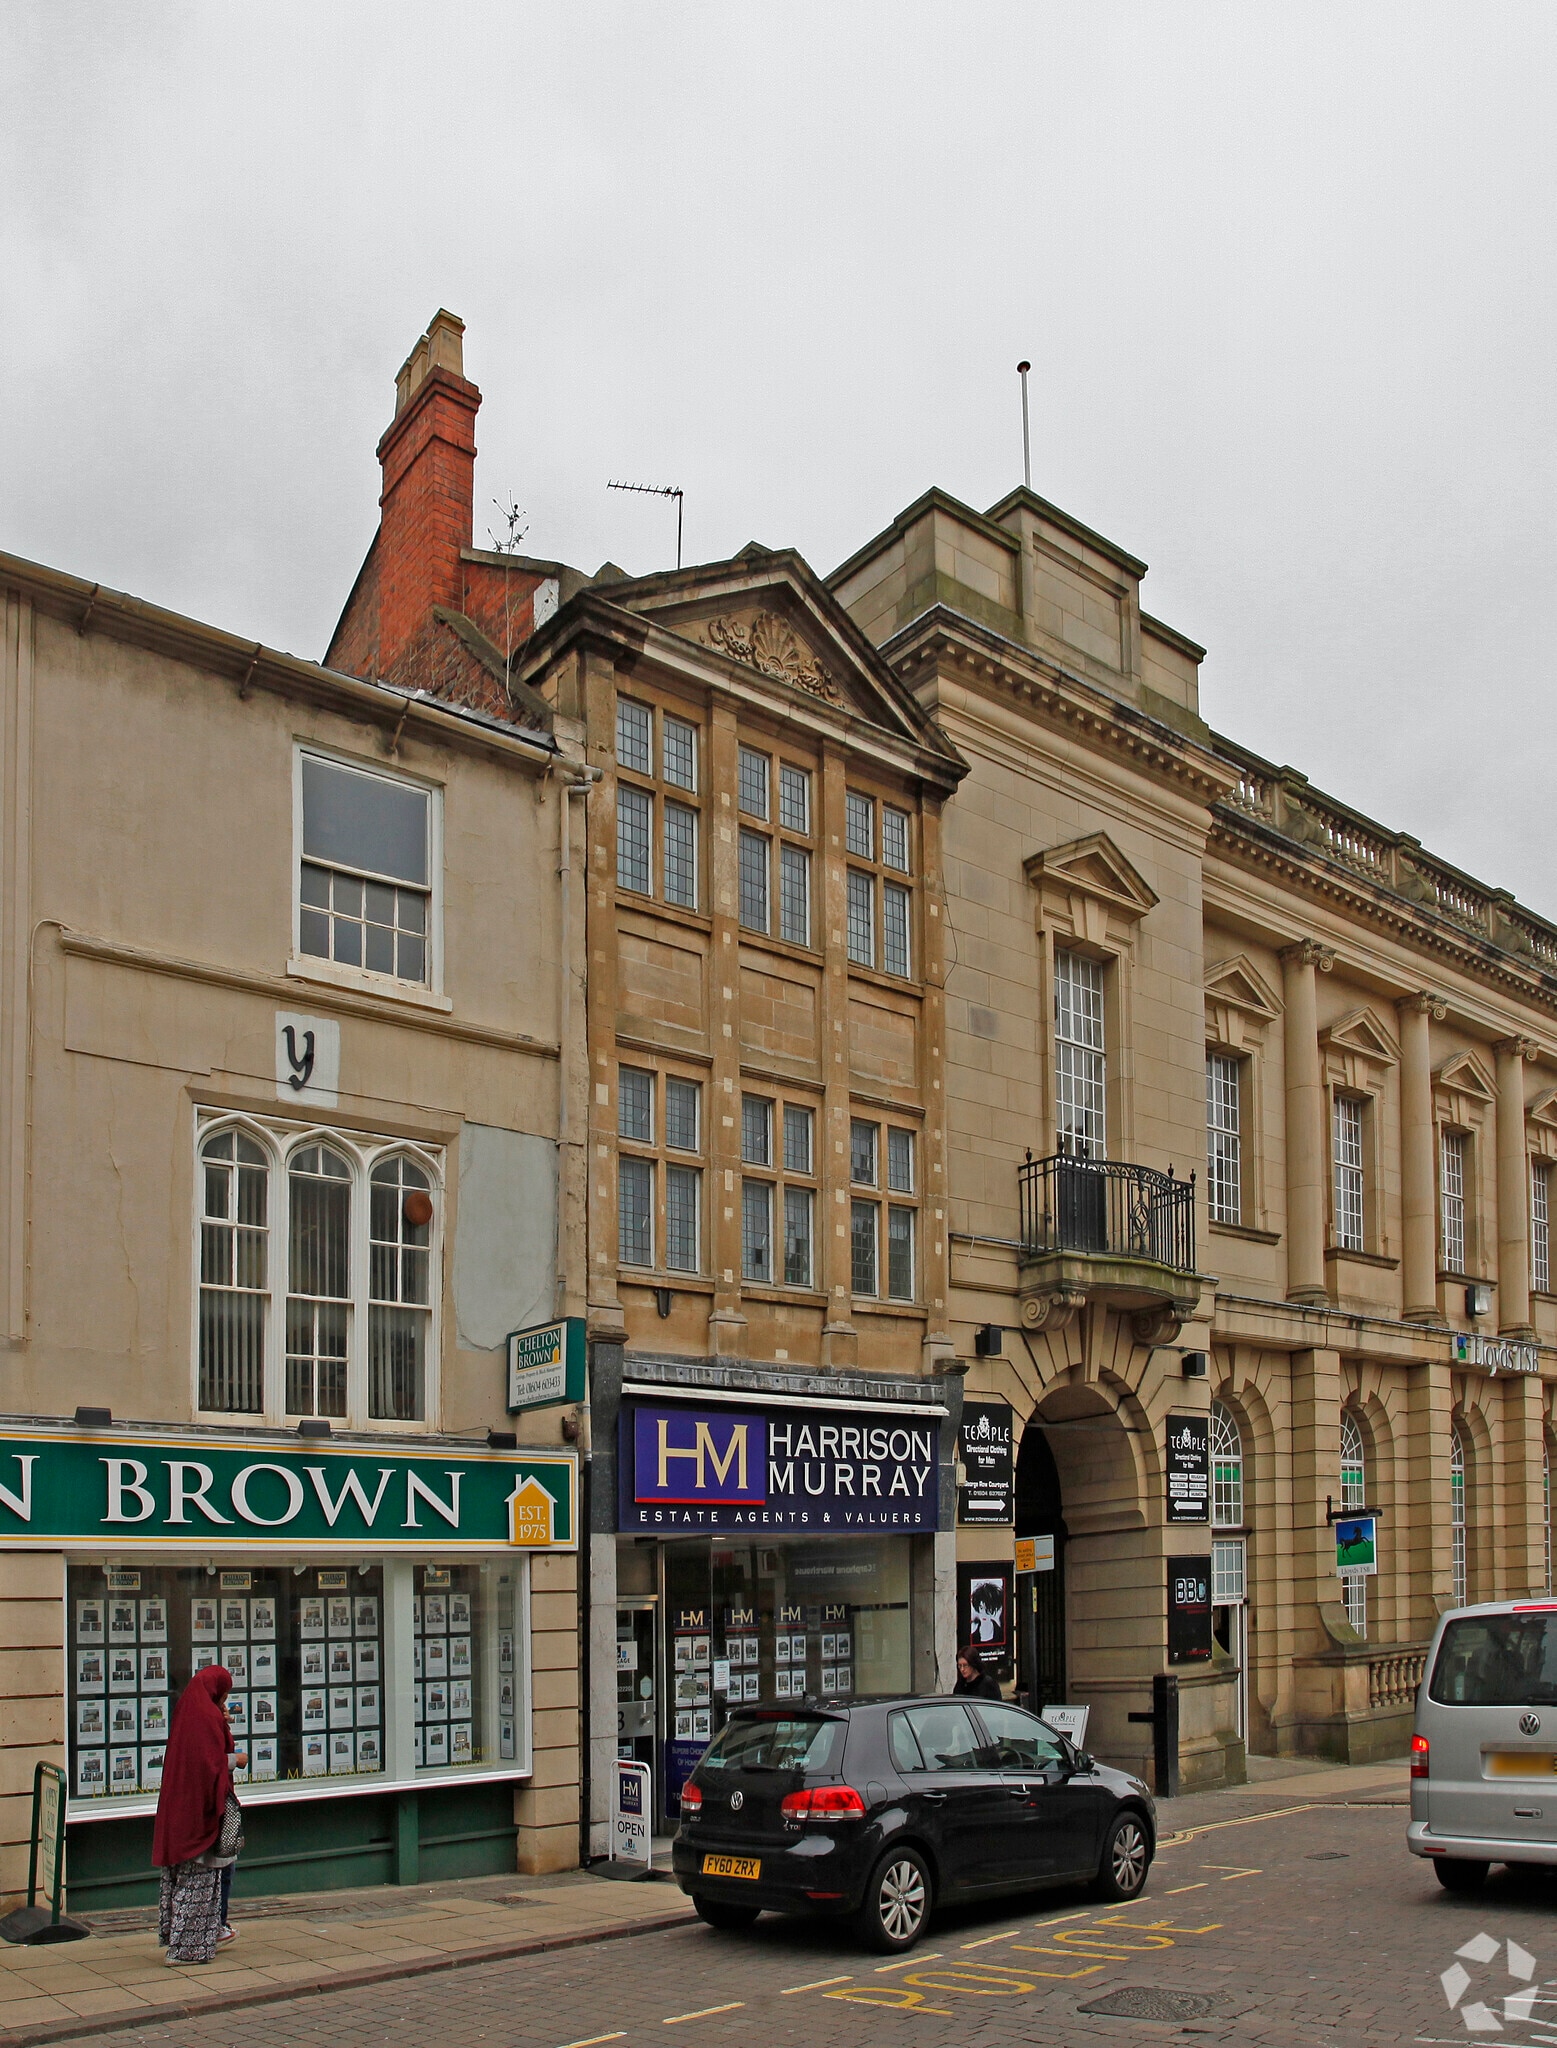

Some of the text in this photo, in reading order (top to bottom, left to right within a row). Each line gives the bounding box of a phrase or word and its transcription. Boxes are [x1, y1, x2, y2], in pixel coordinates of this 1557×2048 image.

[518, 1329, 560, 1353] CHELTON
[518, 1348, 552, 1369] BROWN
[1470, 1335, 1539, 1377] Lloyds TSB
[525, 1380, 541, 1394] 01604
[541, 1375, 561, 1390] 603433
[768, 1422, 932, 1462] HARRISON
[963, 1424, 1010, 1442] TEMPLE
[1170, 1435, 1206, 1452] TEMPLE
[656, 1419, 749, 1490] HM
[768, 1460, 931, 1497] MURRAY
[98, 1457, 466, 1528] BROWN
[518, 1505, 546, 1522] EST.
[639, 1510, 923, 1524] ESTATE AGENTS & VALUERS
[518, 1523, 546, 1539] 1975
[1341, 1567, 1359, 1575] Lloyds
[680, 1610, 704, 1627] HM
[731, 1608, 754, 1625] HM
[780, 1606, 801, 1622] HM
[825, 1604, 846, 1620] HM
[287, 1762, 381, 1780] MANAGEMENT
[622, 1780, 639, 1797] HM
[617, 1821, 645, 1837] OPEN
[706, 1856, 756, 1877] FY60 ZRX
[821, 1914, 1225, 2015] POLICE
